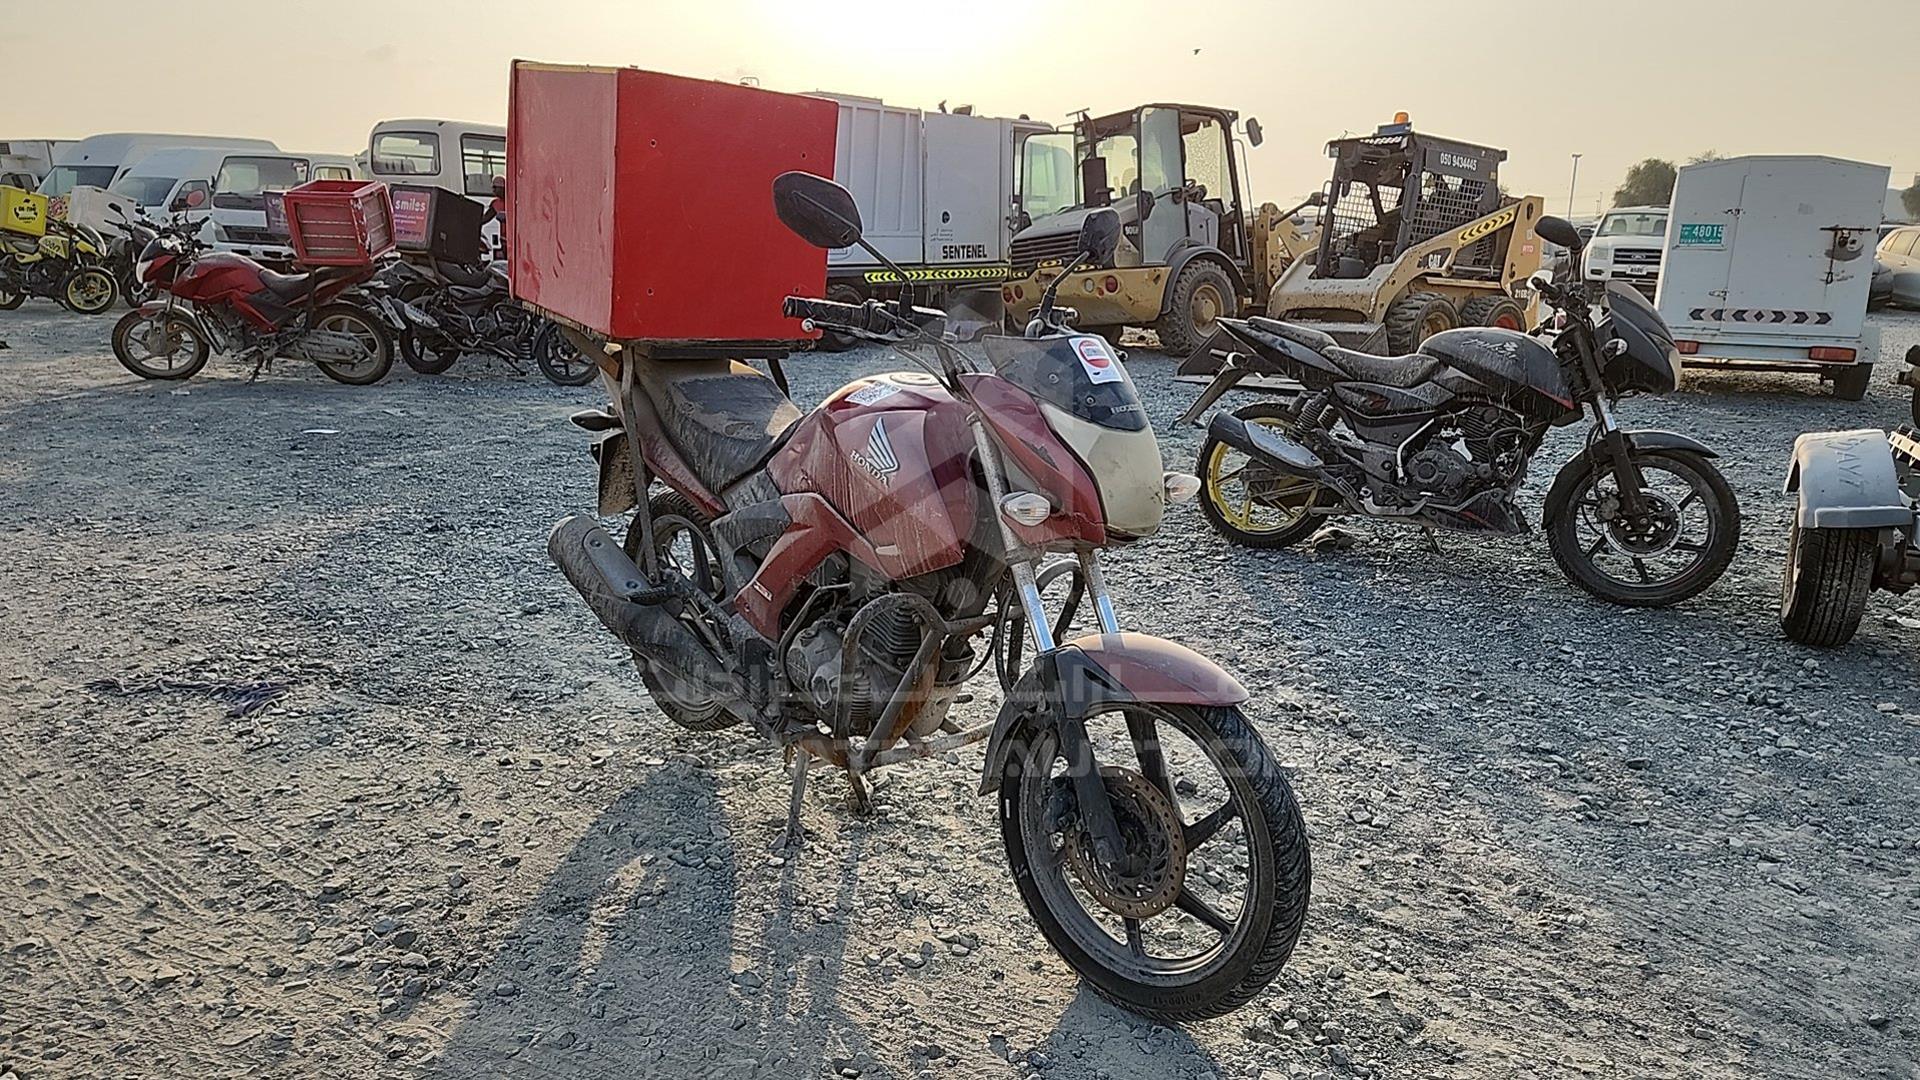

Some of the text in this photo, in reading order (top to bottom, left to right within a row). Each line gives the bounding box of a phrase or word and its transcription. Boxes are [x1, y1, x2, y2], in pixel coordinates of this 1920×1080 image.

[1440, 152, 1452, 166] 050
[395, 198, 426, 211] smiles
[1692, 225, 1722, 238] 48015
[942, 244, 988, 260] SENTENEL
[1428, 254, 1441, 270] CAT
[849, 449, 890, 489] HONDA
